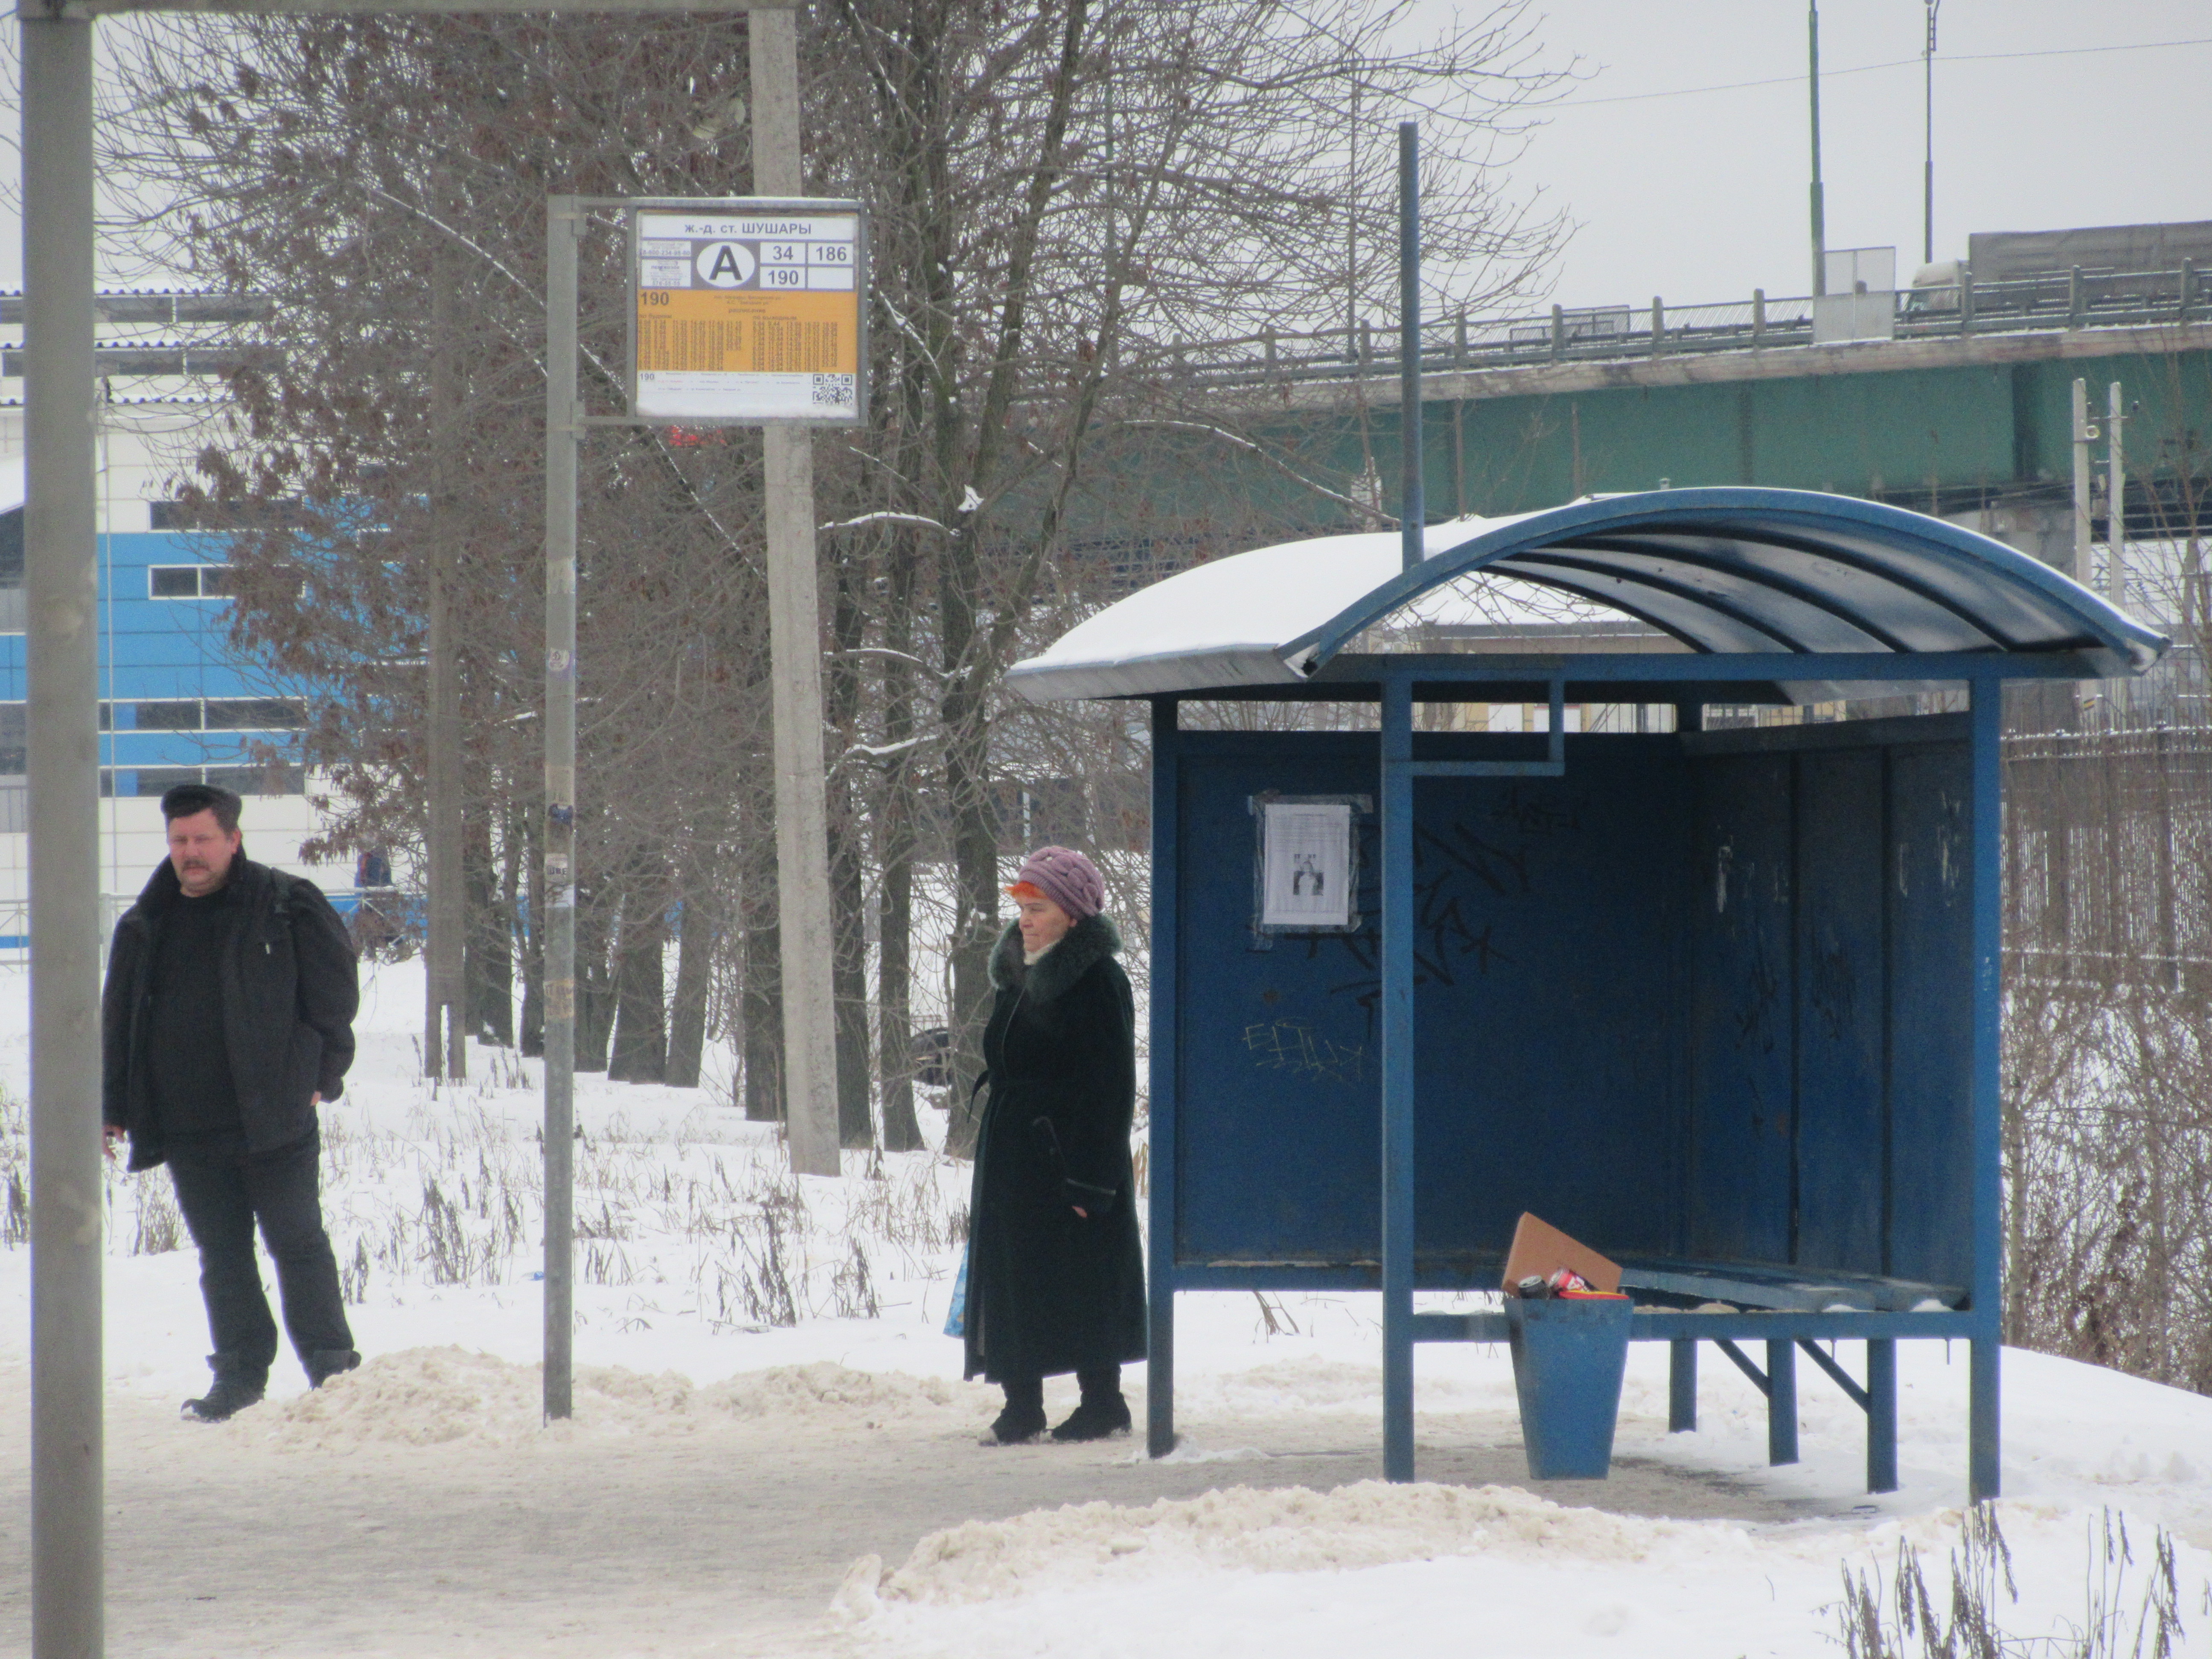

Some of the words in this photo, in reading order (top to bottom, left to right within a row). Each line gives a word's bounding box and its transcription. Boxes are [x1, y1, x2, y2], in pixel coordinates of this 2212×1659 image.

[720, 225, 737, 233] ст.
[742, 223, 811, 234] ШУШАРЫ
[772, 245, 793, 261] 34
[815, 246, 847, 262] 186
[768, 270, 799, 285] 190
[640, 291, 669, 306] 190
